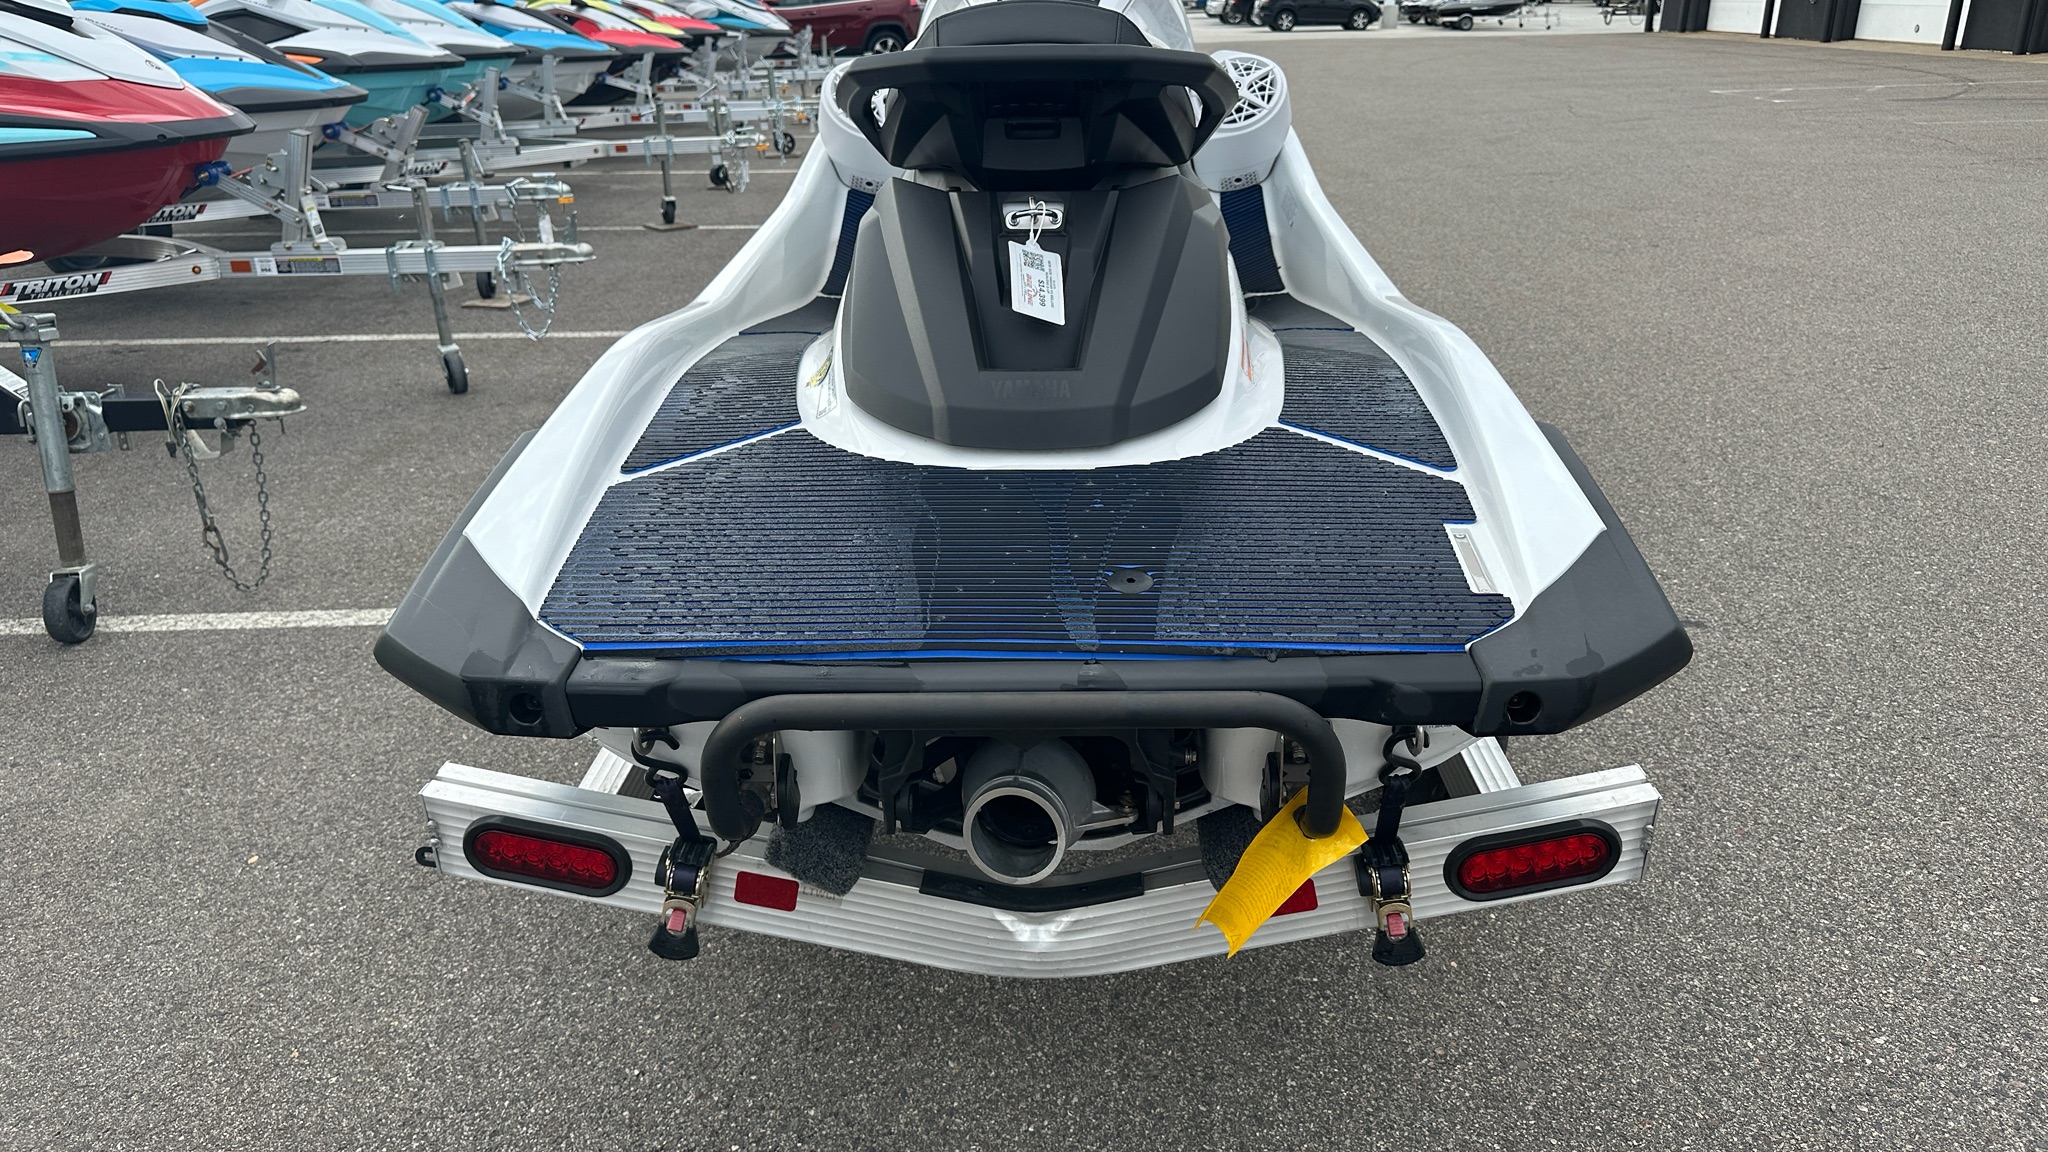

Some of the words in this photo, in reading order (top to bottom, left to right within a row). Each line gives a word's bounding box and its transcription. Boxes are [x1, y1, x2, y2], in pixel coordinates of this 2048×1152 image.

[154, 204, 200, 218] ITON
[12, 272, 103, 295] TRITON
[30, 286, 90, 300] TRAILERS
[1037, 278, 1047, 308] $14,399
[990, 379, 1071, 399] YAMAHA
